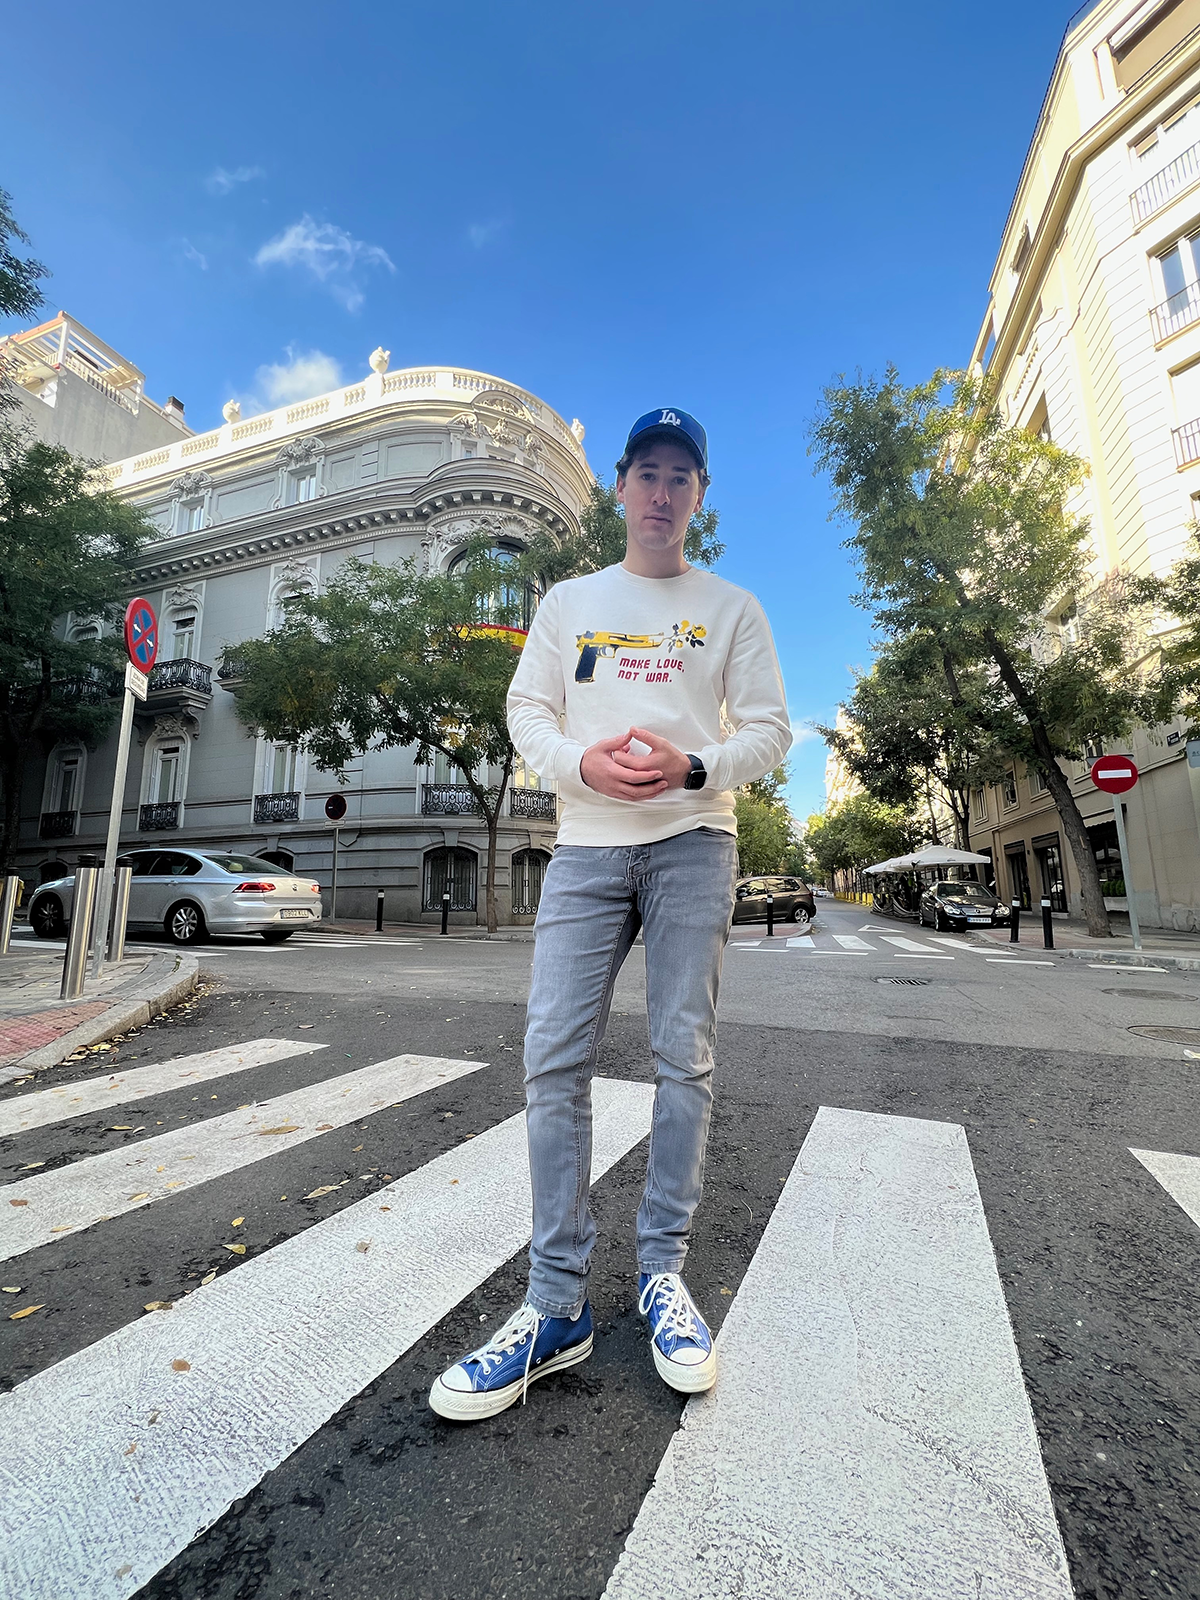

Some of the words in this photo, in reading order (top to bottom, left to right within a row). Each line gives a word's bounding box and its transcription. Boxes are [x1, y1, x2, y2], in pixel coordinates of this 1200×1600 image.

[658, 409, 681, 426] LA
[619, 657, 651, 669] MAKE
[656, 658, 686, 673] LOVE,
[617, 669, 640, 681] NOT
[645, 672, 673, 683] WAR.
